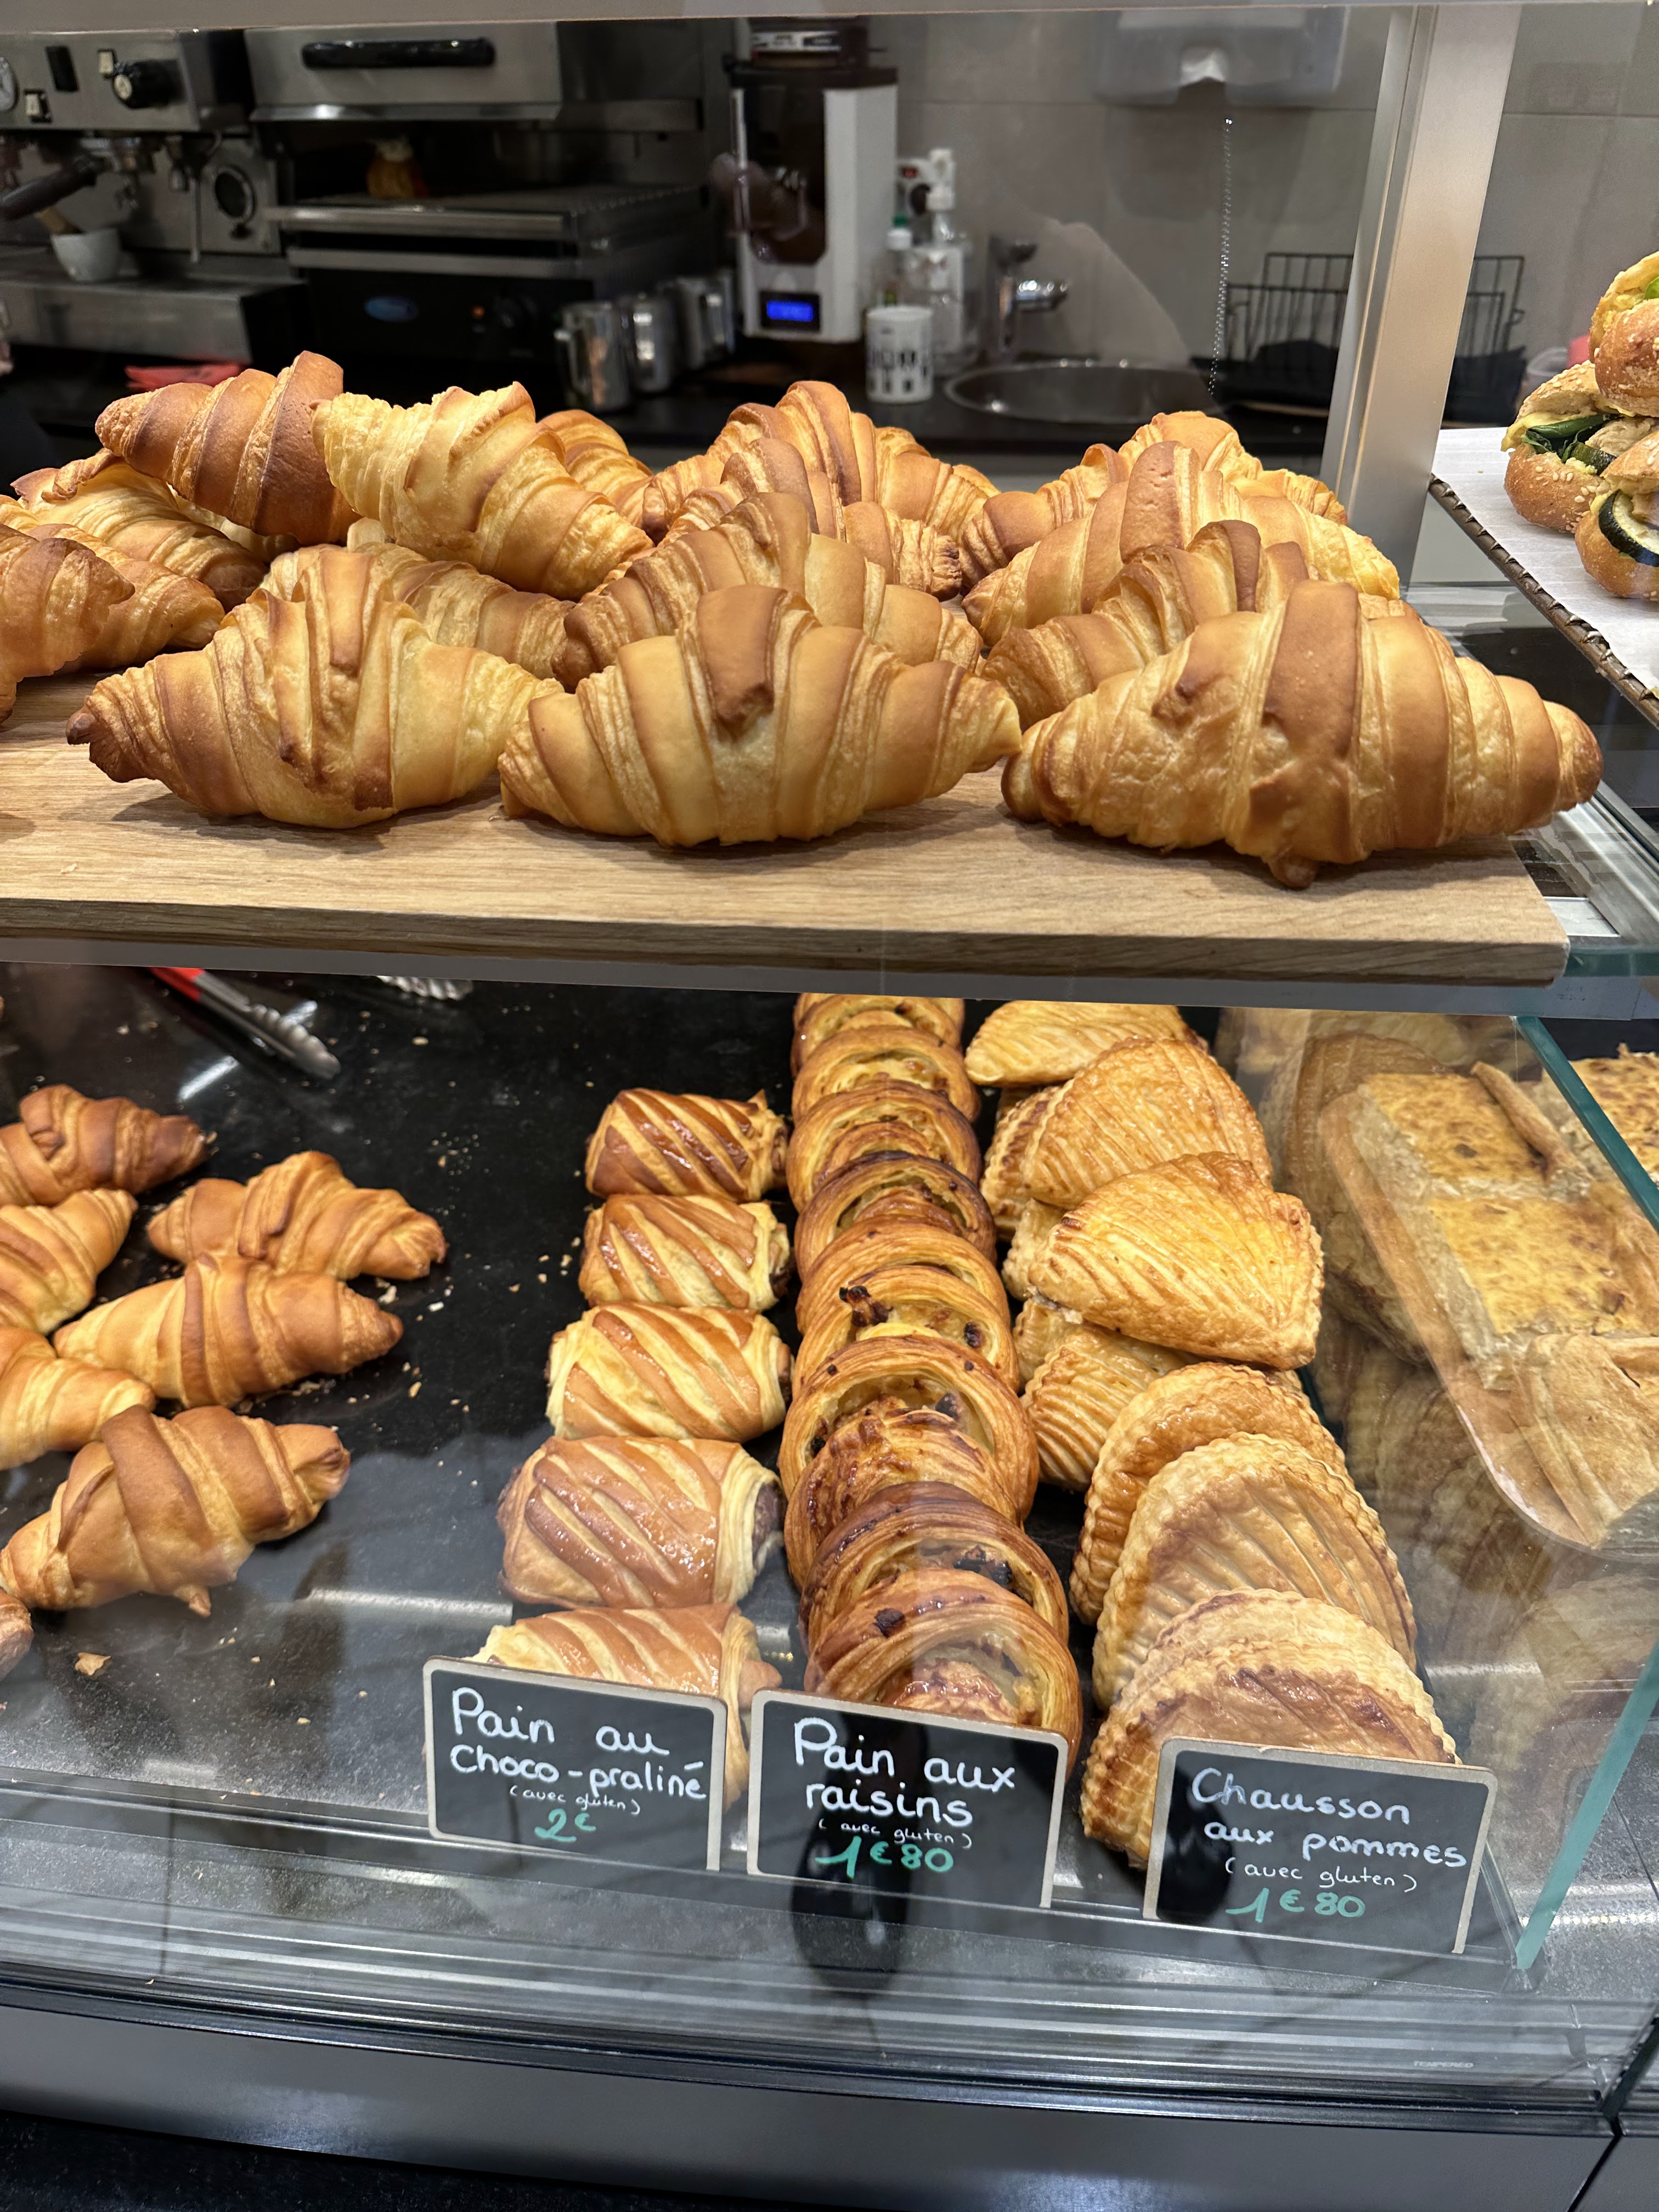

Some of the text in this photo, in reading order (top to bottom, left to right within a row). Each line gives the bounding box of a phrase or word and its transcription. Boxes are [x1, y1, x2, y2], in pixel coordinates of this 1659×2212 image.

[452, 1686, 670, 1755] Pain au
[794, 1717, 1015, 1792] Pain aux
[806, 1779, 973, 1827] raisins
[1192, 1767, 1410, 1825] Chausson
[1204, 1821, 1468, 1867] aux pommes
[1413, 2060, 1474, 2068] TEMPERED
